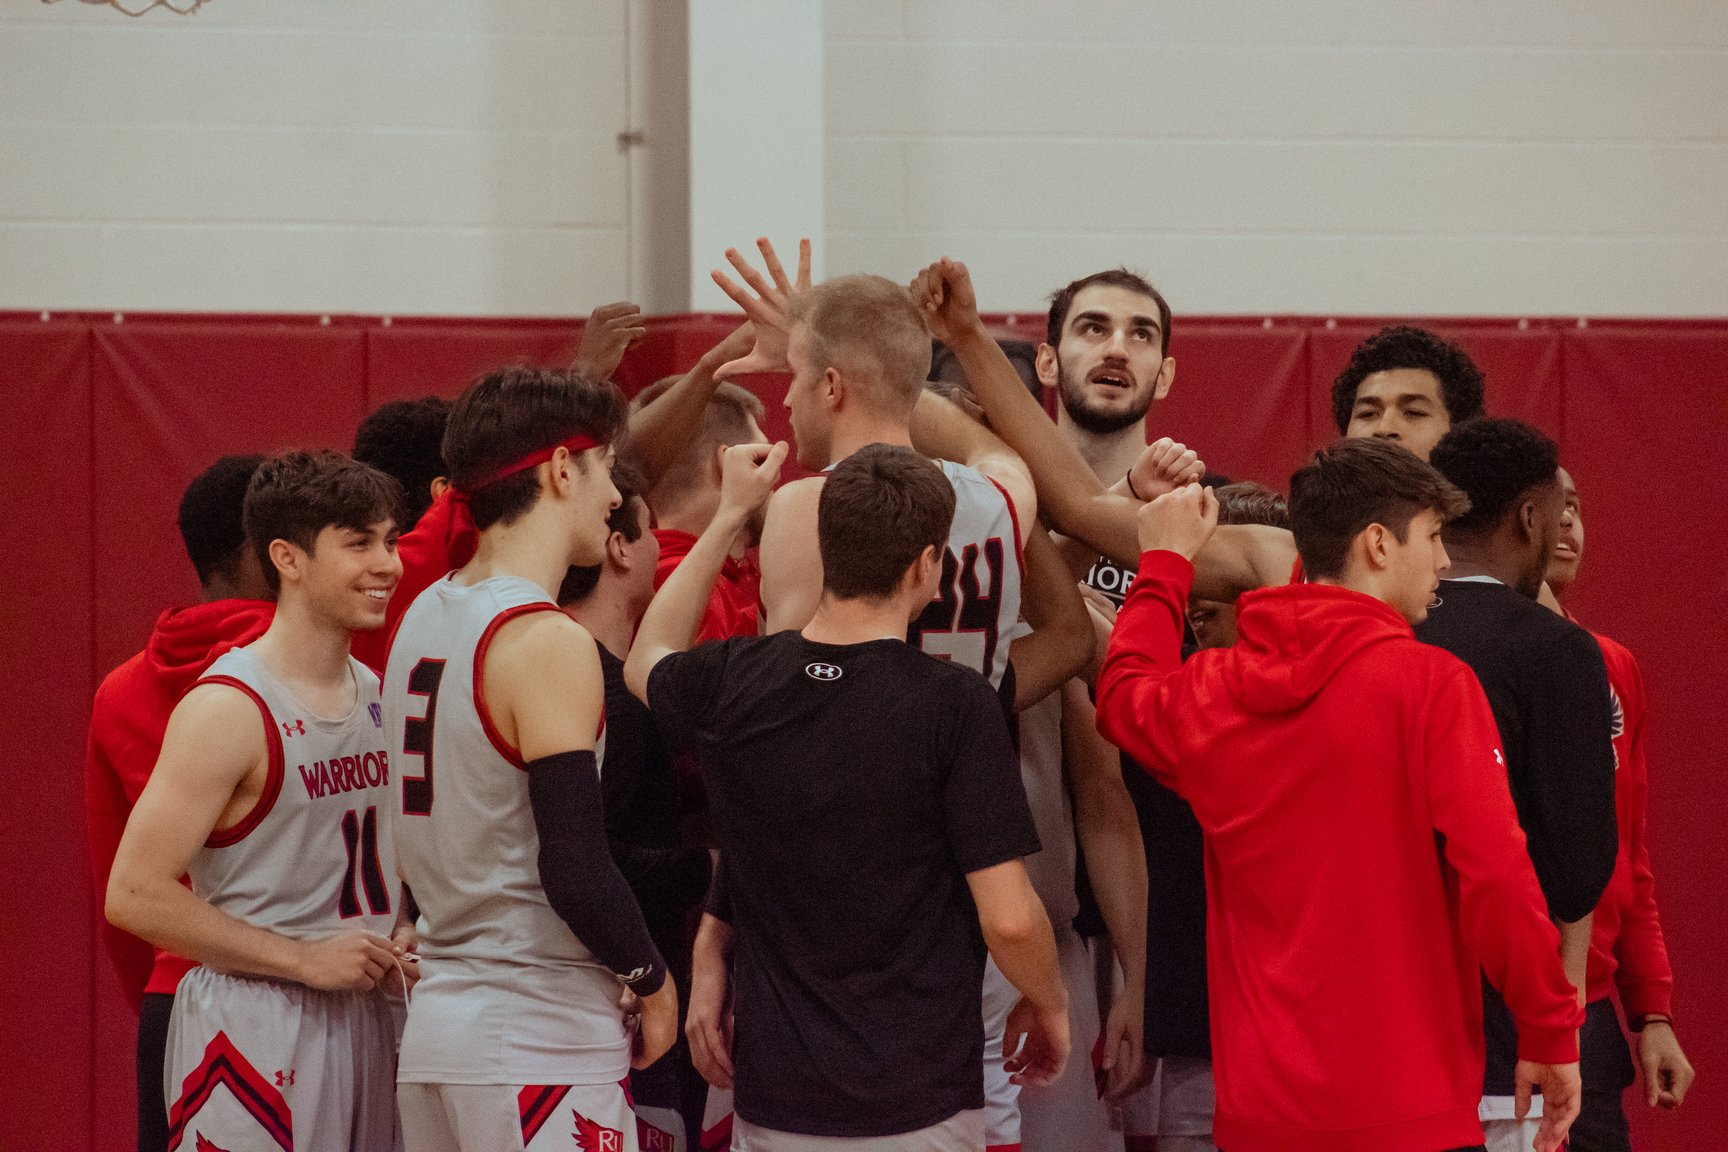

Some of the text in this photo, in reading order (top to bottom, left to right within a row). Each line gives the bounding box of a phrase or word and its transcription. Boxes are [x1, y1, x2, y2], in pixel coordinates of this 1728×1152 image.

[1080, 564, 1137, 595] IOR
[298, 751, 389, 800] WARRIOR
[402, 657, 447, 817] 3
[339, 805, 391, 920] 11
